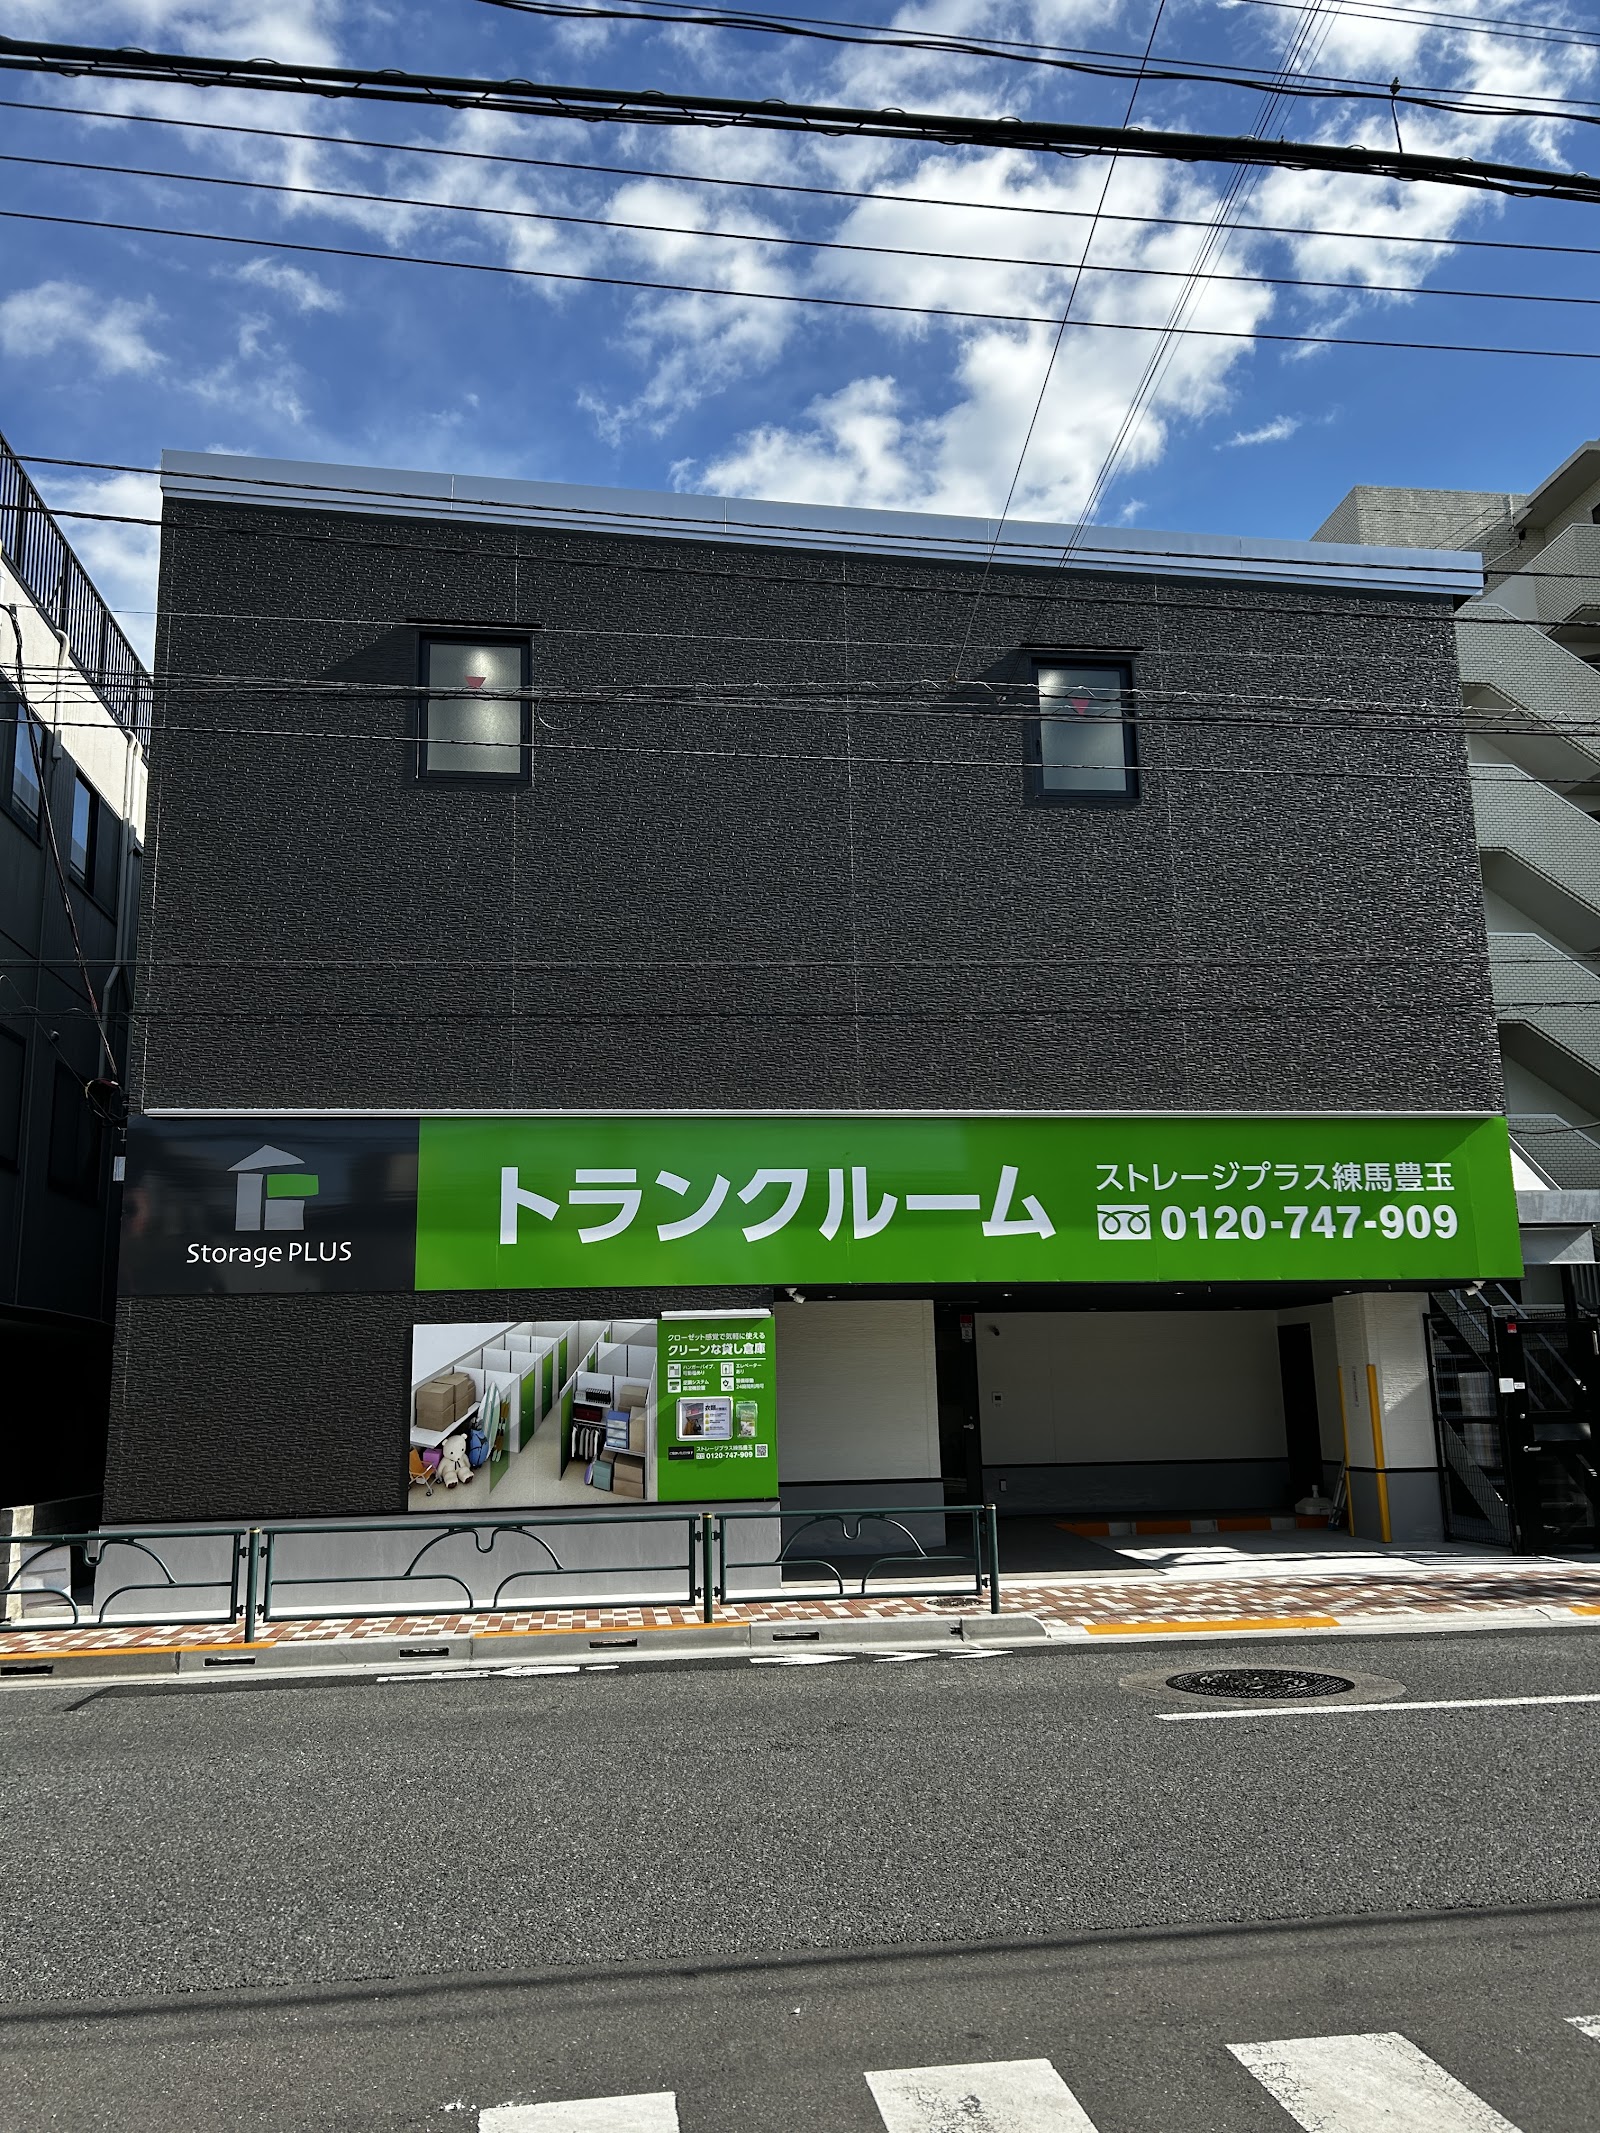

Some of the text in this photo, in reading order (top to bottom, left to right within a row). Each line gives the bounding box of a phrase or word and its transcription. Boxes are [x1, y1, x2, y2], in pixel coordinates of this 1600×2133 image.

[1096, 1161, 1455, 1193] ストレージプラス練馬豊玉
[499, 1164, 1056, 1246] トランクルーム
[1160, 1204, 1459, 1241] 0120-747-909
[186, 1241, 352, 1268] Storage PLUS
[667, 1342, 766, 1356] クリーンな貸し倉庫
[706, 1451, 754, 1459] 0120-747-909
